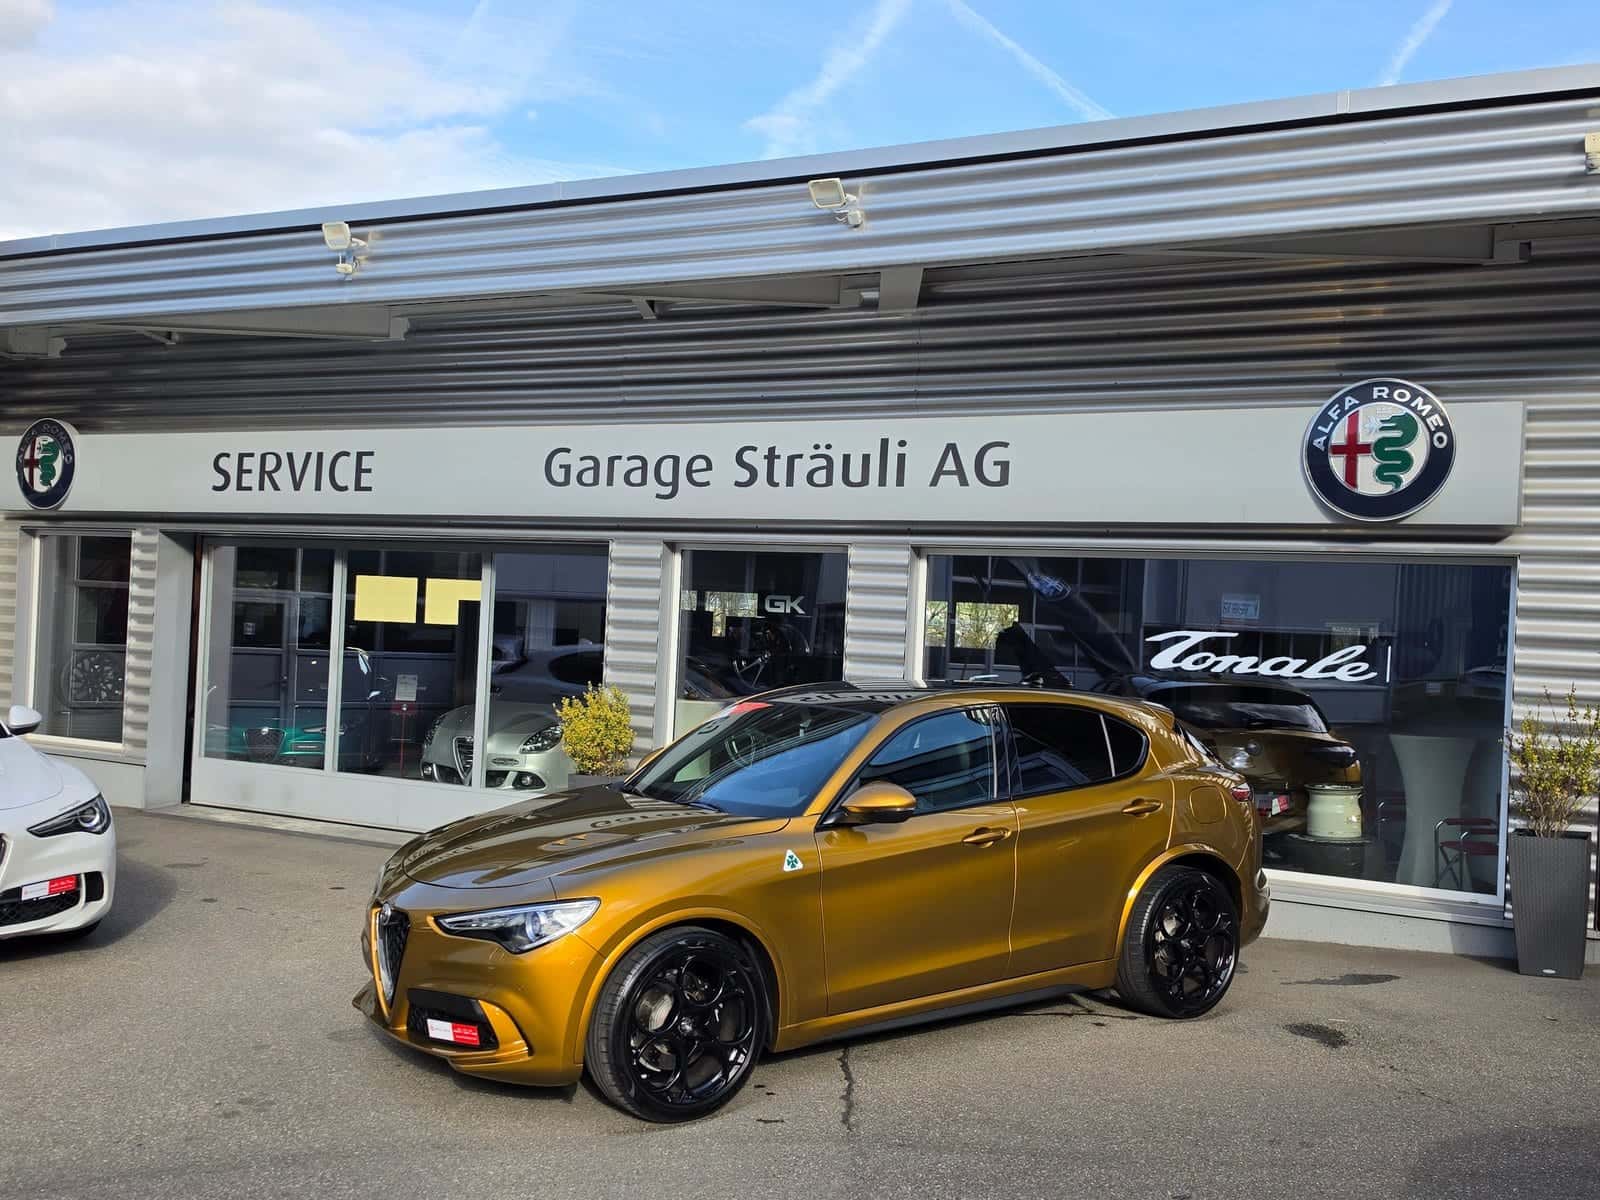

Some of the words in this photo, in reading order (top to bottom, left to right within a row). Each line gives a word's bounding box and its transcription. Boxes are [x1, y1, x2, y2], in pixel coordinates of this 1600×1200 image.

[1312, 395, 1361, 452] ALFA
[1372, 385, 1448, 450] ROMEO
[211, 450, 375, 492] SERVICE
[544, 446, 713, 500] Garage
[733, 437, 908, 488] Sträuli
[929, 441, 1010, 488] AG
[764, 594, 806, 615] GK
[1144, 630, 1378, 682] Tonale
